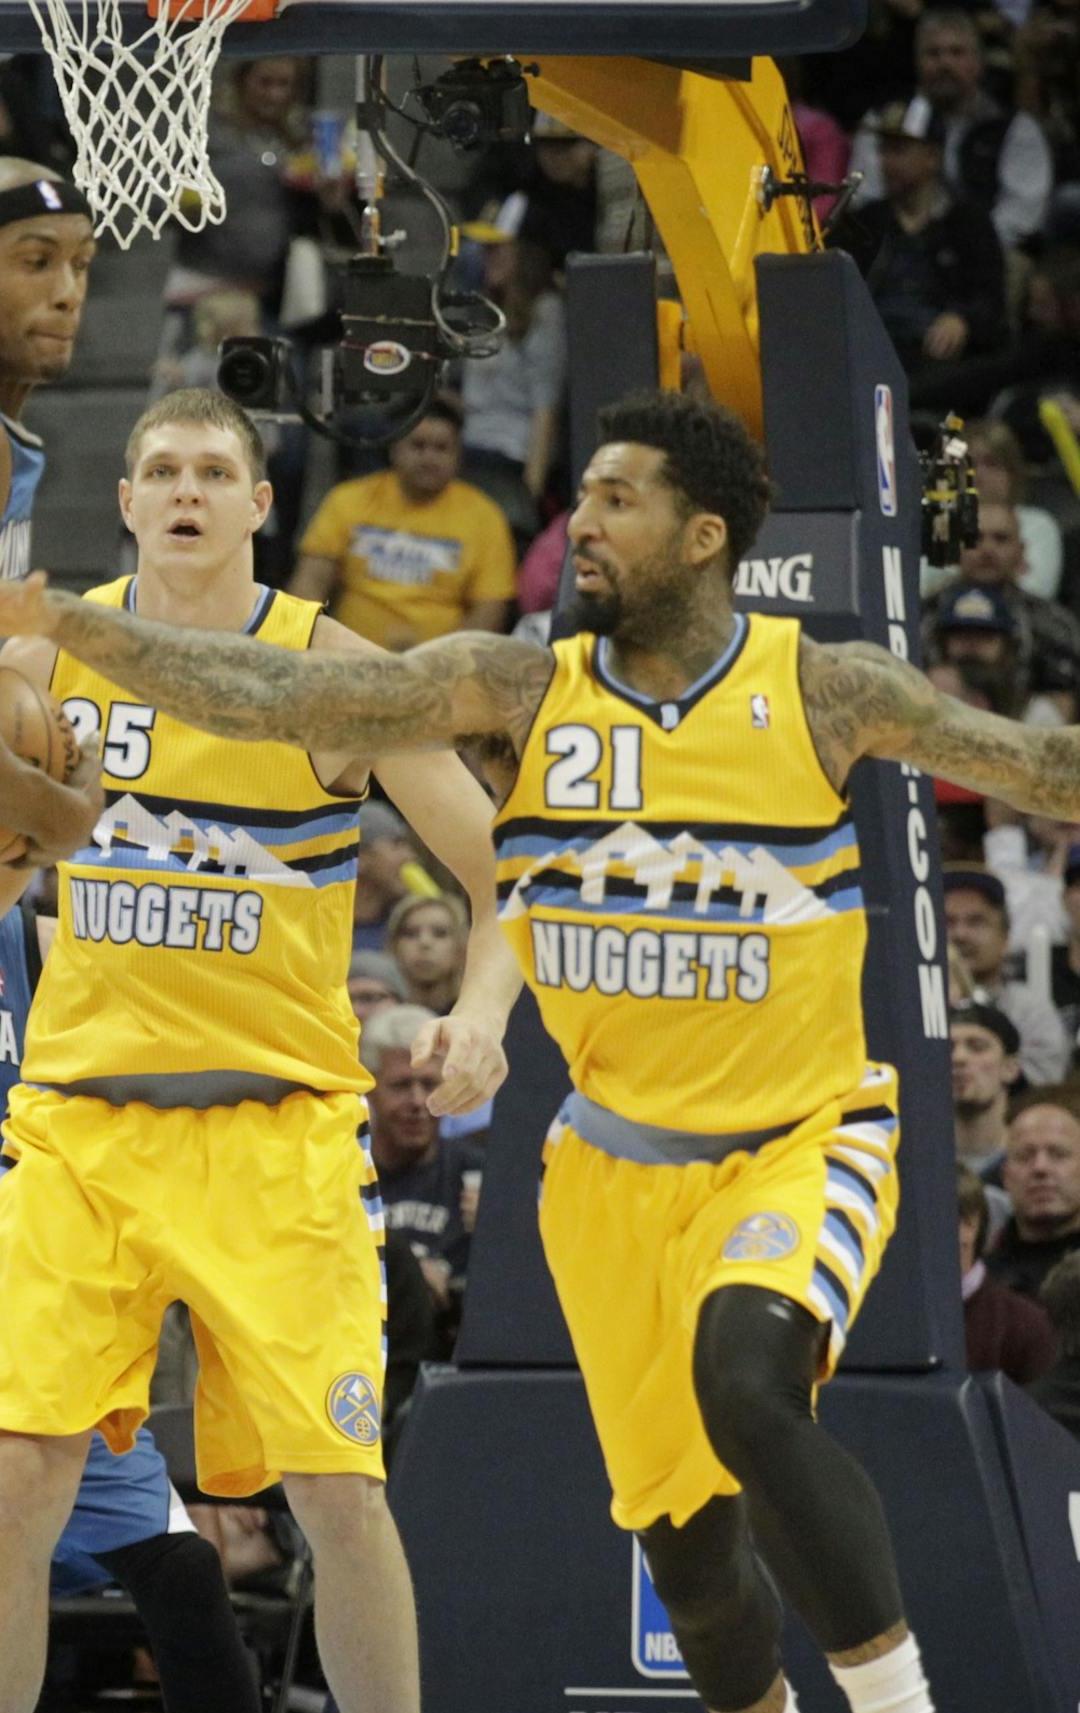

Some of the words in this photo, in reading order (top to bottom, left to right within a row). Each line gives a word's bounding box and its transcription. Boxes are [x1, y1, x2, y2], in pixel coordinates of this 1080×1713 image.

[734, 553, 813, 602] ING
[544, 723, 643, 810] 21
[70, 877, 263, 954] NUGGETS
[530, 919, 770, 1003] NUGGETS
[645, 1631, 684, 1662] NB
